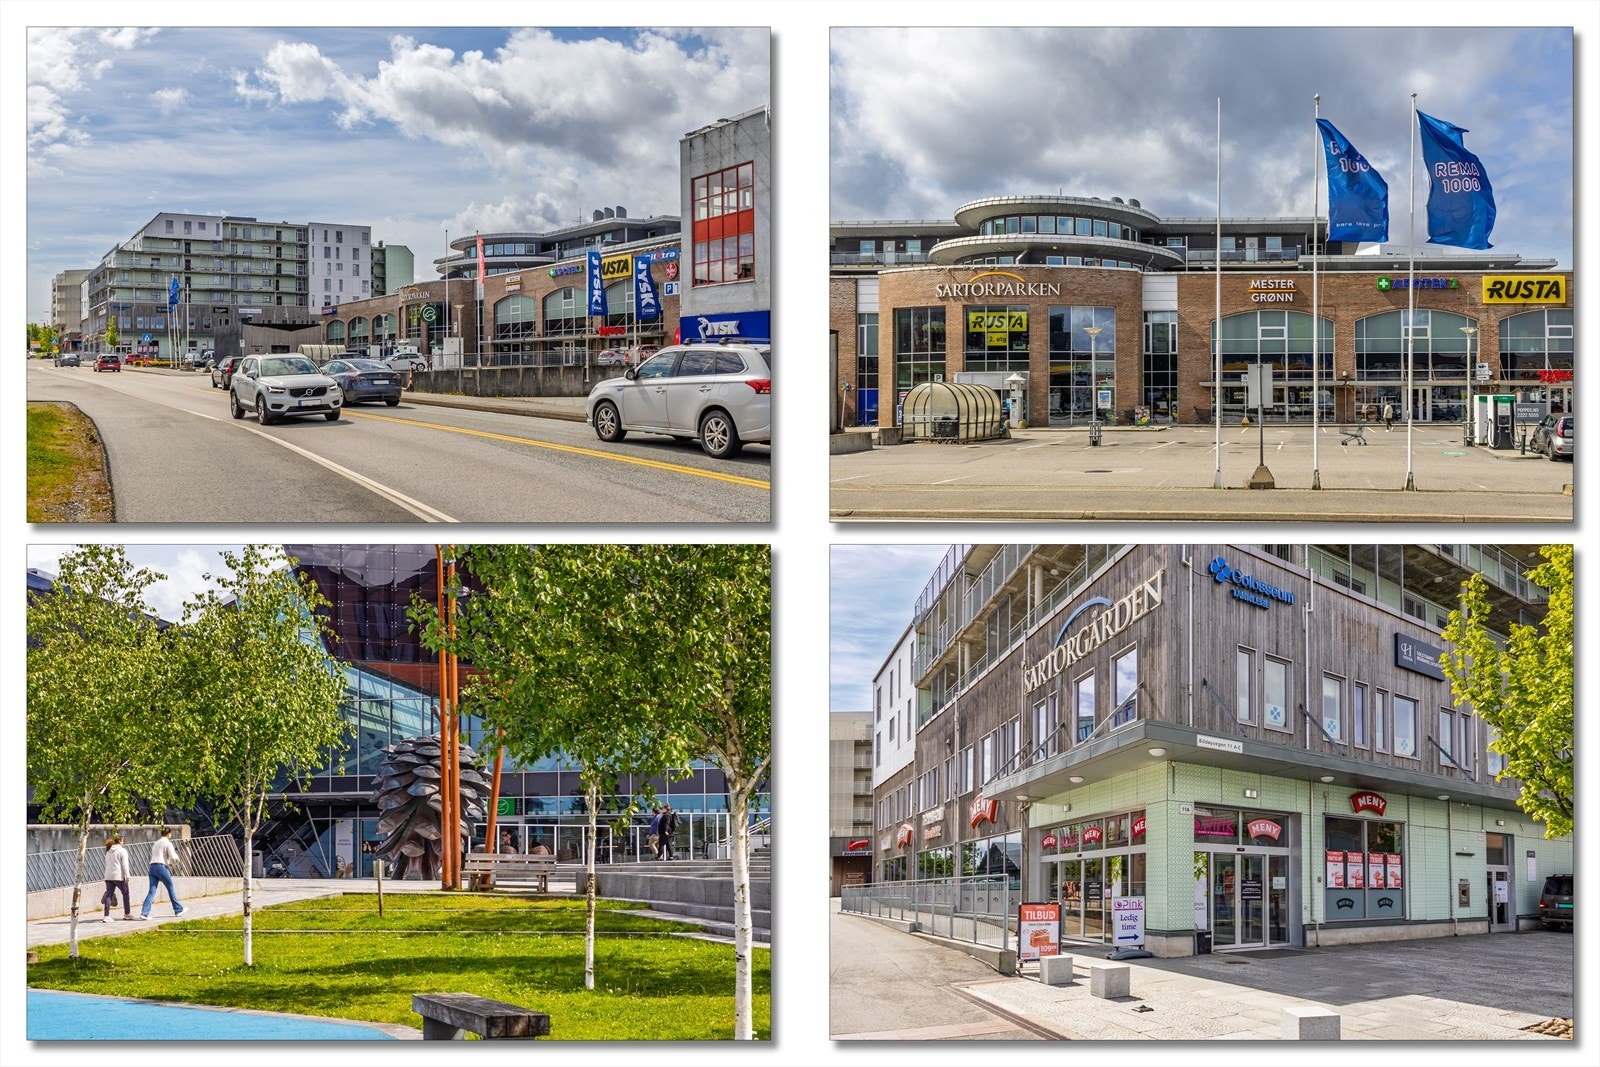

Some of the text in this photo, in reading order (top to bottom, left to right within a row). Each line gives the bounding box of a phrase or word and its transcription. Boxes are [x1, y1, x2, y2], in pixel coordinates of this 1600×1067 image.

[1435, 161, 1480, 177] REMA
[1442, 178, 1481, 193] 1000
[602, 259, 629, 276] USTA
[592, 256, 602, 303] JYSK
[637, 260, 656, 307] JYSK
[1251, 279, 1294, 289] MESTER
[1392, 277, 1458, 289] APOTEK 1
[935, 282, 1061, 297] SARTORPARKEN
[1487, 280, 1561, 299] RUSTA
[1251, 293, 1293, 302] GRØNN
[706, 321, 740, 336] JYSK
[971, 315, 1023, 328] RUSTA
[1232, 568, 1296, 605] Colosseum
[1024, 568, 1165, 696] SARTORGÅRDEN
[970, 799, 993, 819] MENY
[1358, 795, 1386, 809] MENY
[1134, 821, 1146, 833] ME
[1251, 823, 1278, 835] MENY
[1043, 837, 1056, 846] MENY
[1084, 831, 1101, 841] MENY
[1122, 899, 1143, 909] Pink
[1120, 914, 1138, 922] Ledig
[1121, 923, 1136, 931] time
